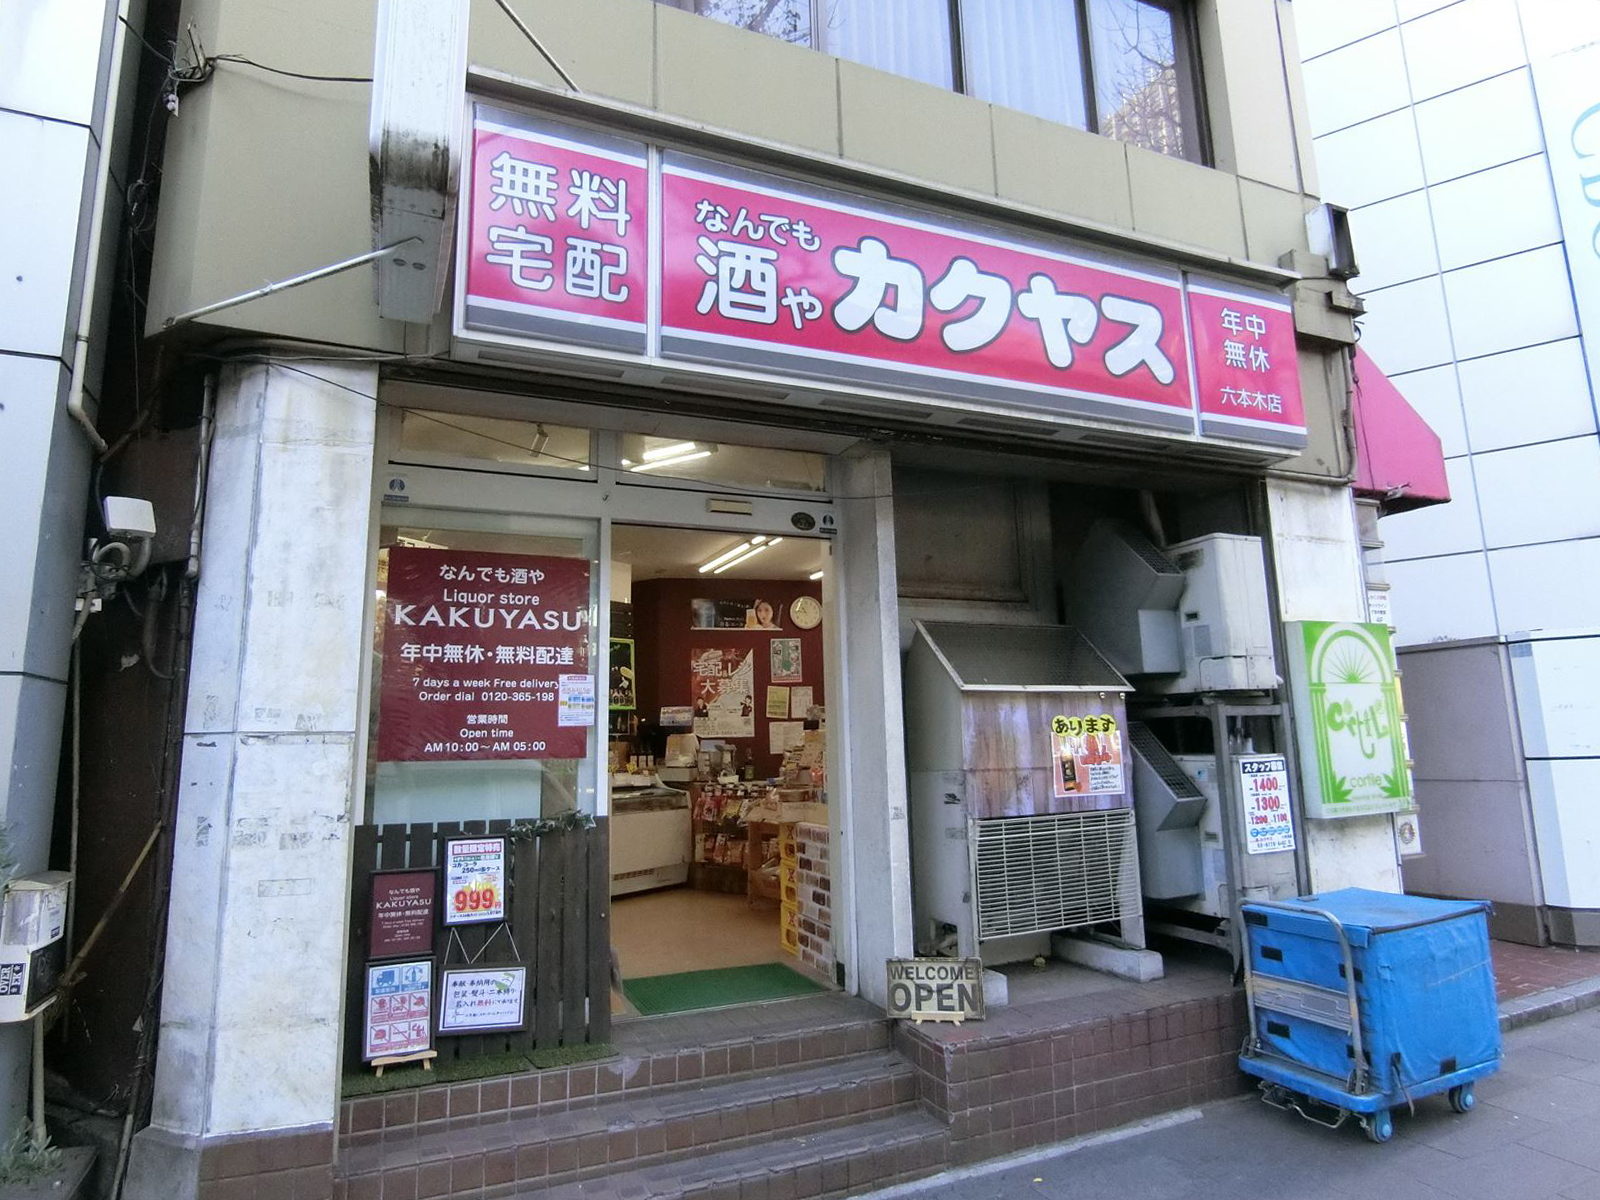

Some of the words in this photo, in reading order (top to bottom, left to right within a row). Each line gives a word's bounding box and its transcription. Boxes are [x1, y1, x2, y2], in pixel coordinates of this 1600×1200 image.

[490, 151, 631, 237] 無料
[695, 200, 821, 251] なんでも
[486, 225, 629, 302] 宅配
[696, 236, 823, 329] 酒や
[832, 236, 1175, 385] カクヤス
[1220, 307, 1266, 340] 年中
[1223, 339, 1270, 373] 無休
[1220, 386, 1282, 414] 六本木店
[440, 564, 545, 585] なんでも酒や
[444, 589, 494, 604] Liquor
[500, 592, 540, 605] store
[394, 605, 582, 631] KAKUYASU
[400, 643, 574, 665] 年中無休・無料配達
[413, 677, 419, 687] 7
[423, 677, 449, 689] days
[463, 678, 490, 688] week
[494, 678, 517, 688] Free
[520, 677, 559, 689] delivery
[419, 692, 451, 701] Order
[455, 692, 475, 701] dial
[481, 692, 555, 701] 0120-365-198
[467, 714, 508, 724] 営業時間
[1054, 717, 1114, 735] あります
[460, 728, 487, 738] Open
[491, 728, 513, 737] time
[514, 742, 546, 751] 05:00
[1253, 777, 1279, 792] 1400
[1255, 796, 1280, 811] 1300
[376, 898, 432, 909] KAKUYASU
[890, 966, 975, 980] WELCOME
[889, 982, 980, 1012] OPEN
